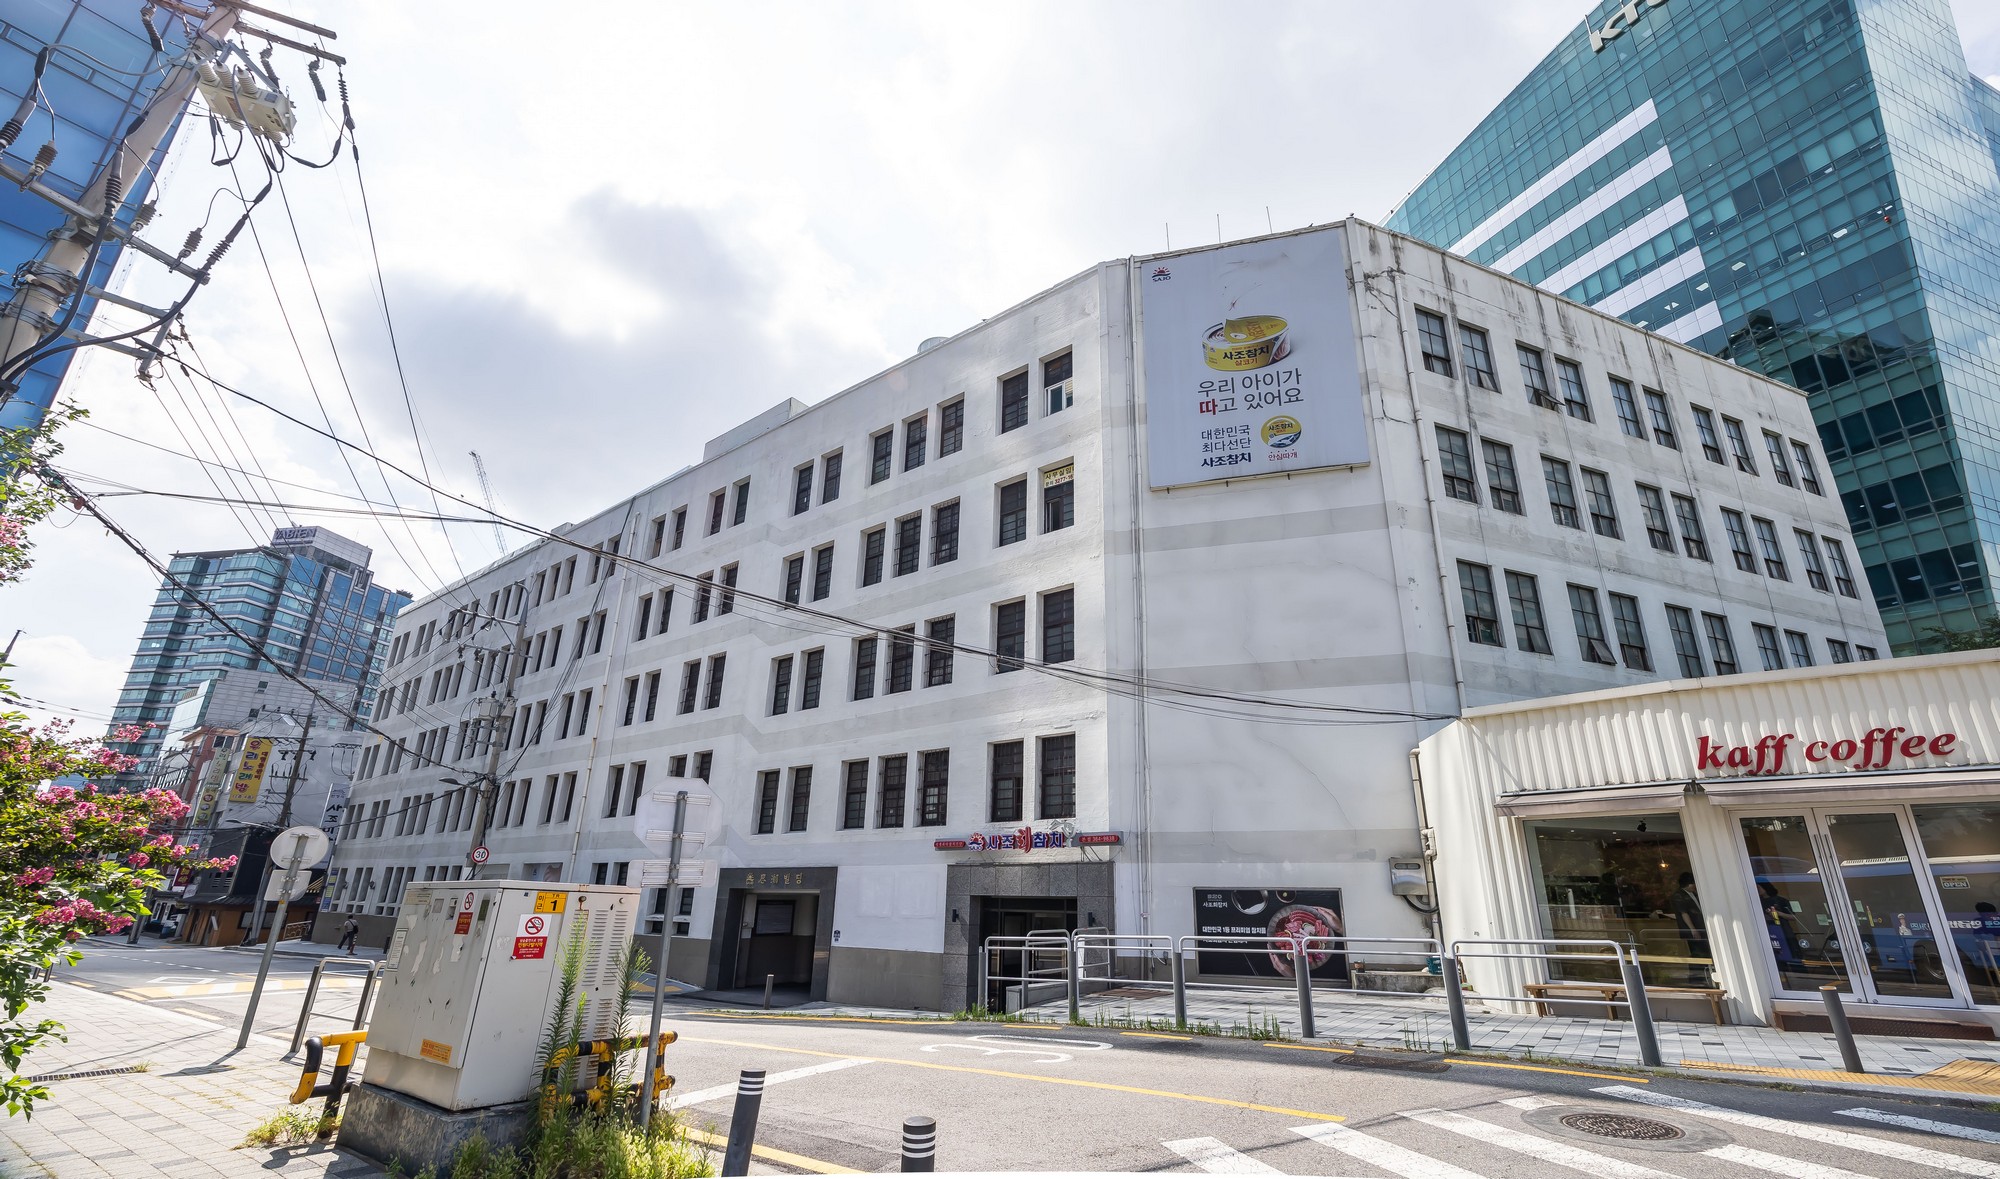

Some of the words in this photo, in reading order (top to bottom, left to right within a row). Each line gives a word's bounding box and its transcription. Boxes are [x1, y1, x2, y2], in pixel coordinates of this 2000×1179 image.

[1223, 345, 1269, 360] 사조참치
[1235, 358, 1258, 366] 살코기
[1198, 377, 1235, 397] 우리
[1242, 368, 1302, 391] 아이가
[1199, 397, 1238, 415] 따고
[1244, 387, 1304, 411] 있어요
[1201, 424, 1251, 440] 대한민국
[1268, 422, 1293, 431] 사조참치
[1202, 437, 1251, 453] 최다선단
[1201, 452, 1252, 467] 사조참치
[1268, 451, 1298, 462] 안심따개
[1697, 733, 1795, 775] kaff
[1805, 727, 1956, 770] coffee
[474, 850, 487, 859] 30
[550, 900, 558, 911] 1
[1231, 926, 1250, 934] 프리미엄
